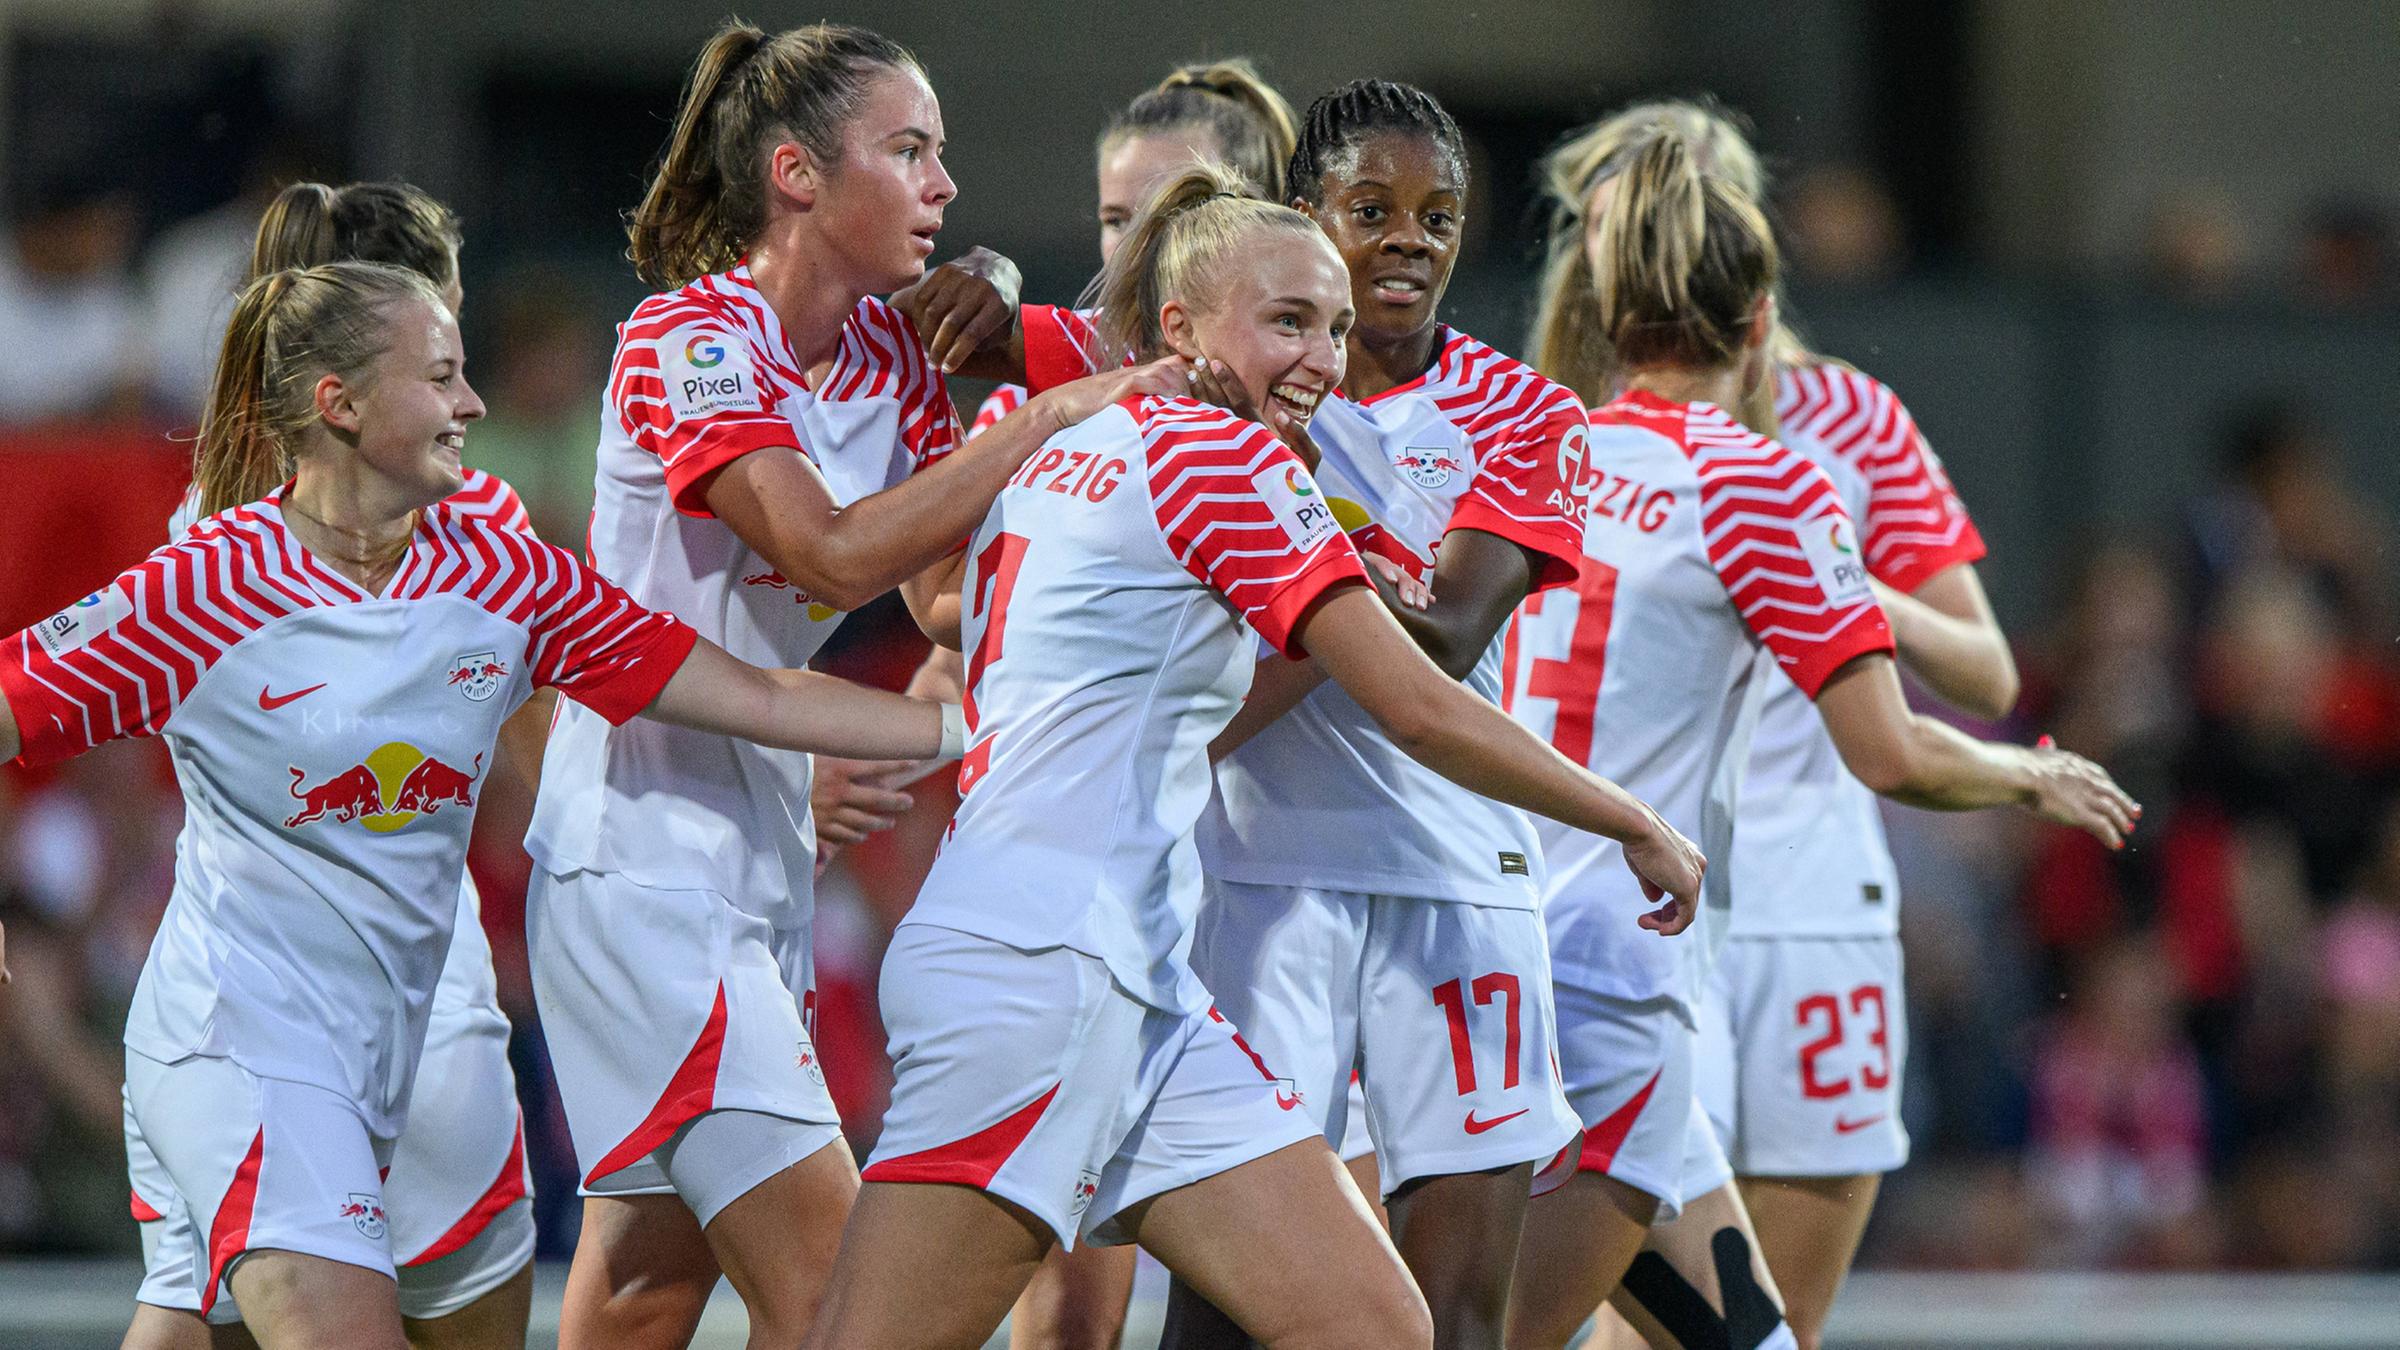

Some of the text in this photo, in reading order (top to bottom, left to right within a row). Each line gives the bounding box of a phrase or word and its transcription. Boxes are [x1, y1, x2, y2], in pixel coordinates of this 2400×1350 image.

[683, 372, 742, 404] Pixel
[1006, 447, 1127, 503] IPZIG
[1432, 971, 1522, 1097] 17
[1795, 985, 1891, 1099] 23
